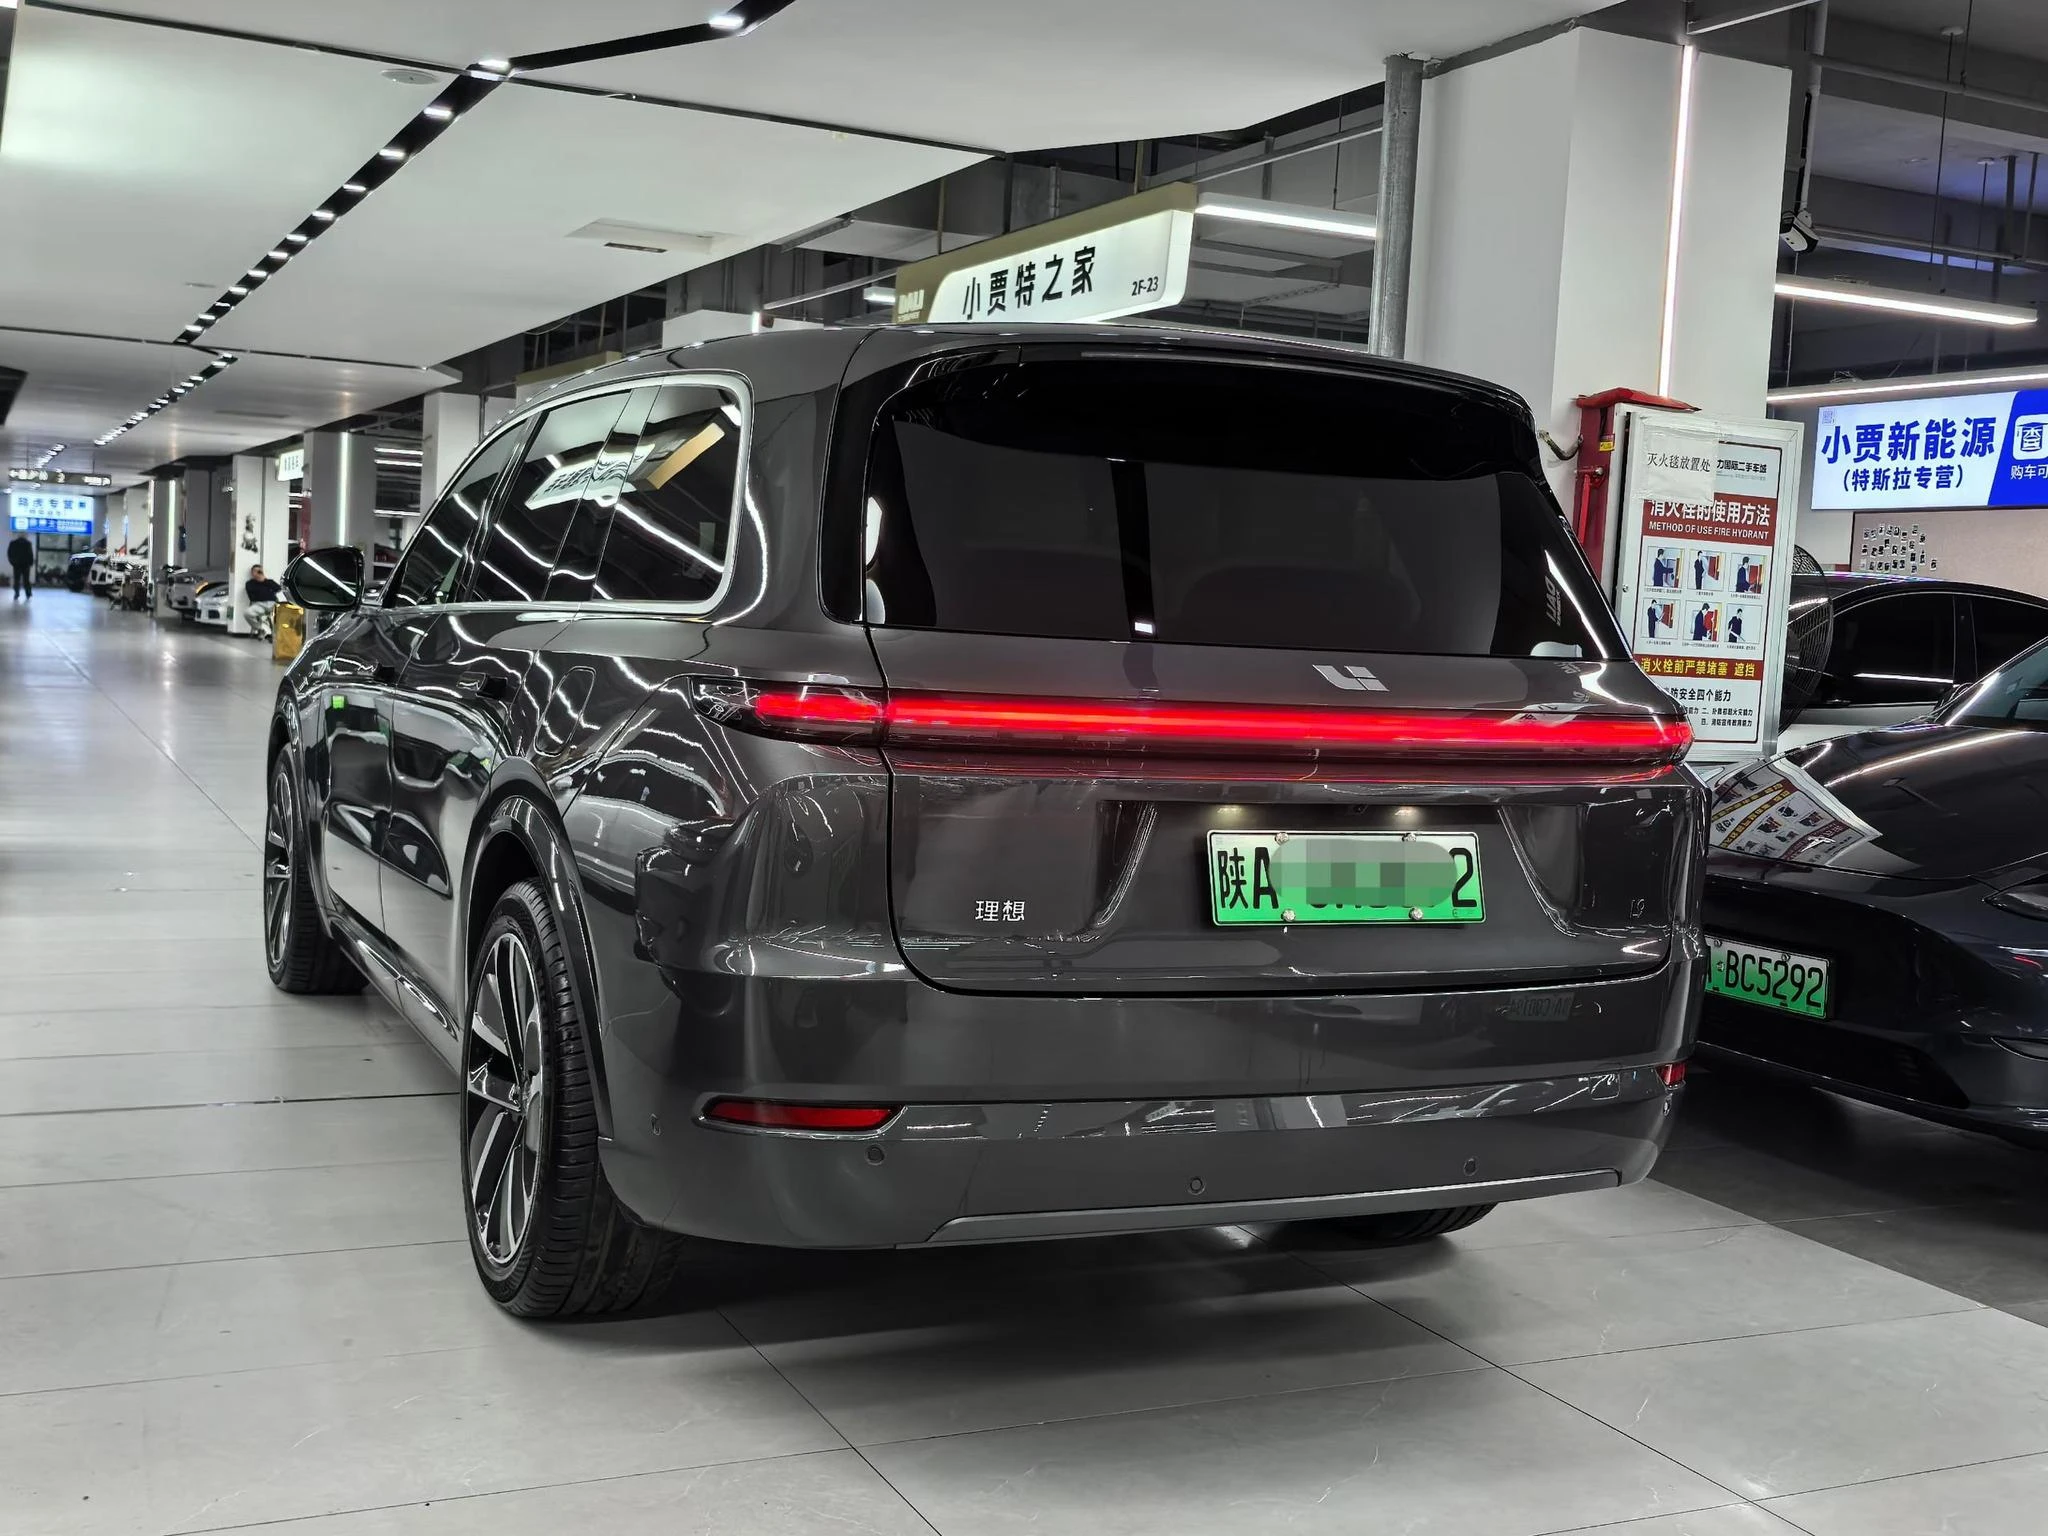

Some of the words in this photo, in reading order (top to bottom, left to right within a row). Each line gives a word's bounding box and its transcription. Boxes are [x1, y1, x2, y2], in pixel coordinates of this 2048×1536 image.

[962, 245, 1096, 321] 小贾特之家
[1131, 275, 1160, 297] 2F-23
[1821, 416, 1997, 465] 小贾新能源
[1647, 452, 1711, 473] 灭火毯放置处
[1843, 464, 1964, 493] （特斯拉专营）
[1648, 521, 1683, 532] METHOD
[1685, 524, 1696, 533] OF
[1697, 525, 1713, 535] USE
[1714, 527, 1731, 537] FIRE
[1732, 528, 1769, 540] HYDRANT
[1641, 657, 1728, 676] 消火栓前严禁堵塞
[1734, 662, 1755, 677] 遮挡
[1664, 686, 1731, 702] 防安全四个能力
[975, 899, 1025, 922] 理想
[1725, 949, 1824, 1008] BC5292
